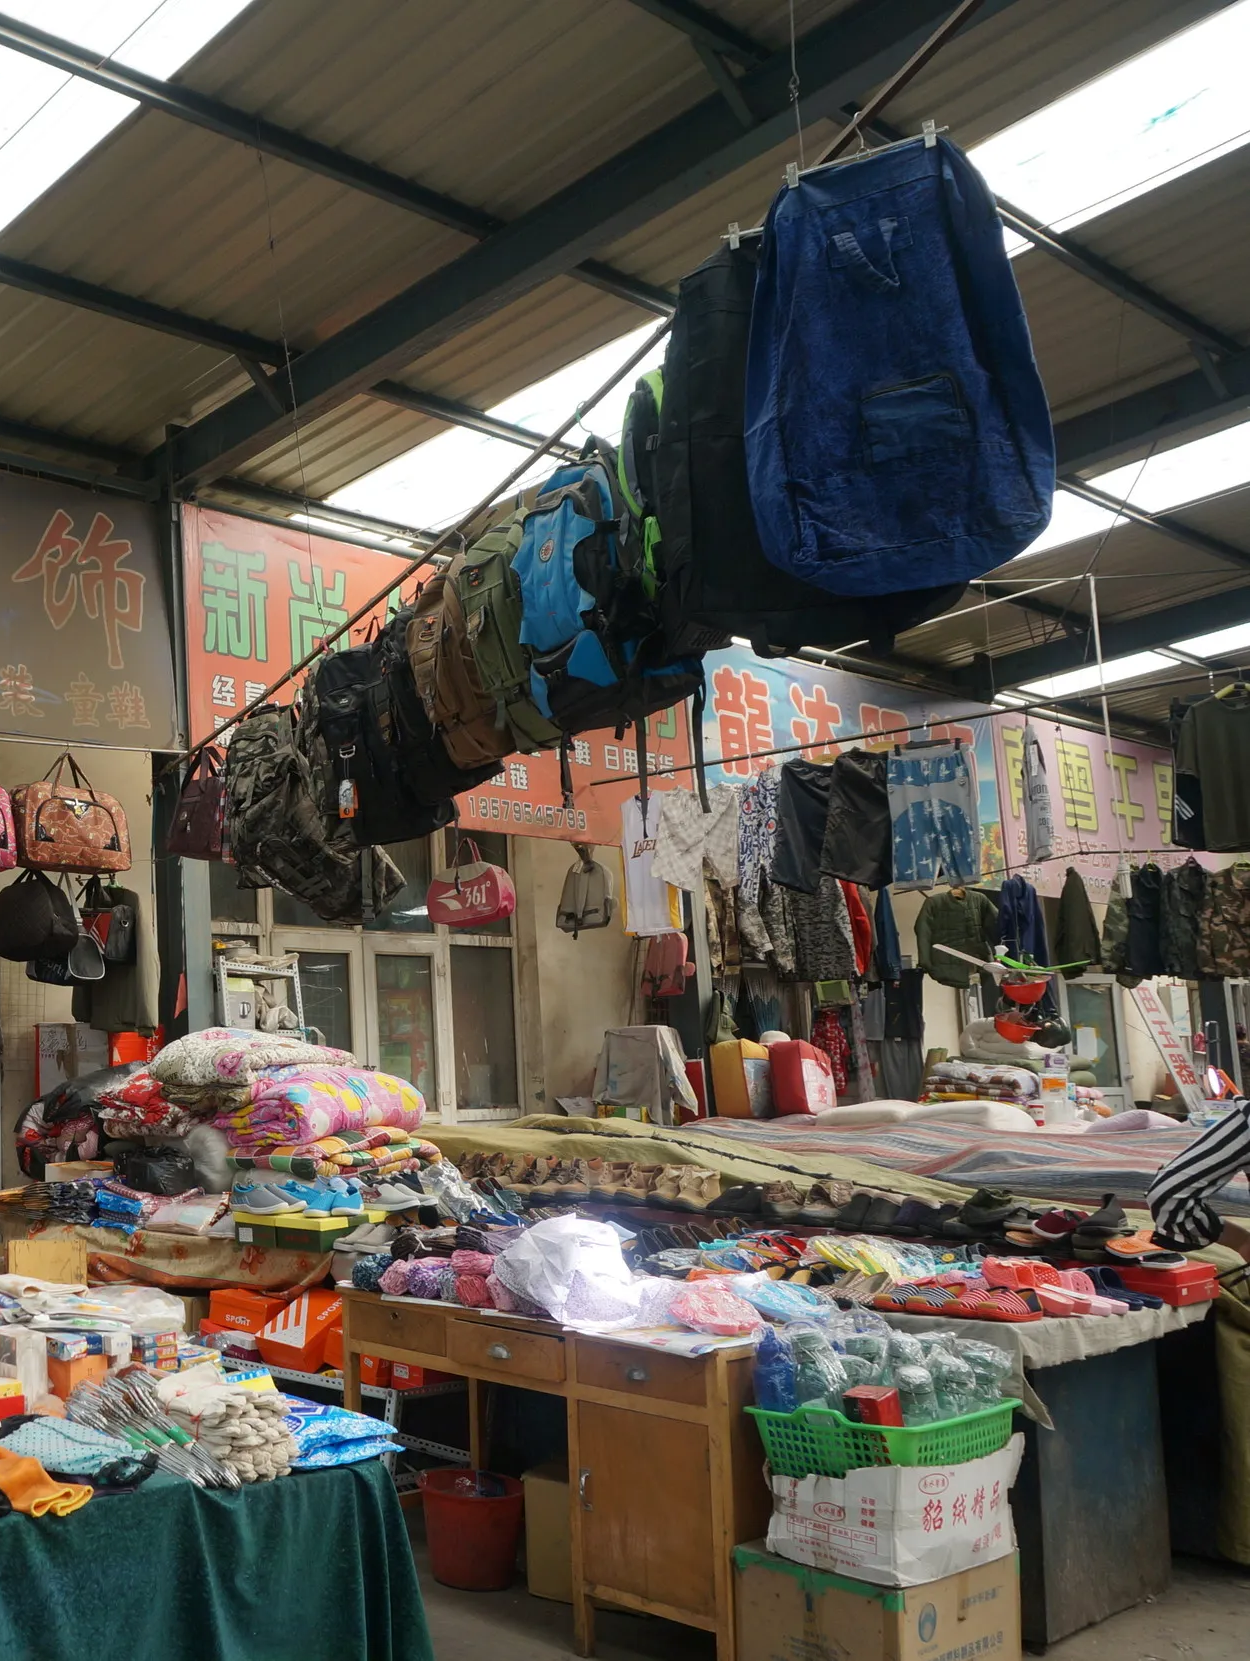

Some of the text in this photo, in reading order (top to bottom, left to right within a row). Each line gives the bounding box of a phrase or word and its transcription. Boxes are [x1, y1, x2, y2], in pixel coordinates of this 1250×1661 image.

[65, 673, 150, 729] 童鞋
[468, 796, 587, 831] 13579545793
[1136, 986, 1197, 1086] 田玉器
[225, 1313, 251, 1327] SPORT
[317, 1297, 342, 1321] SPORT
